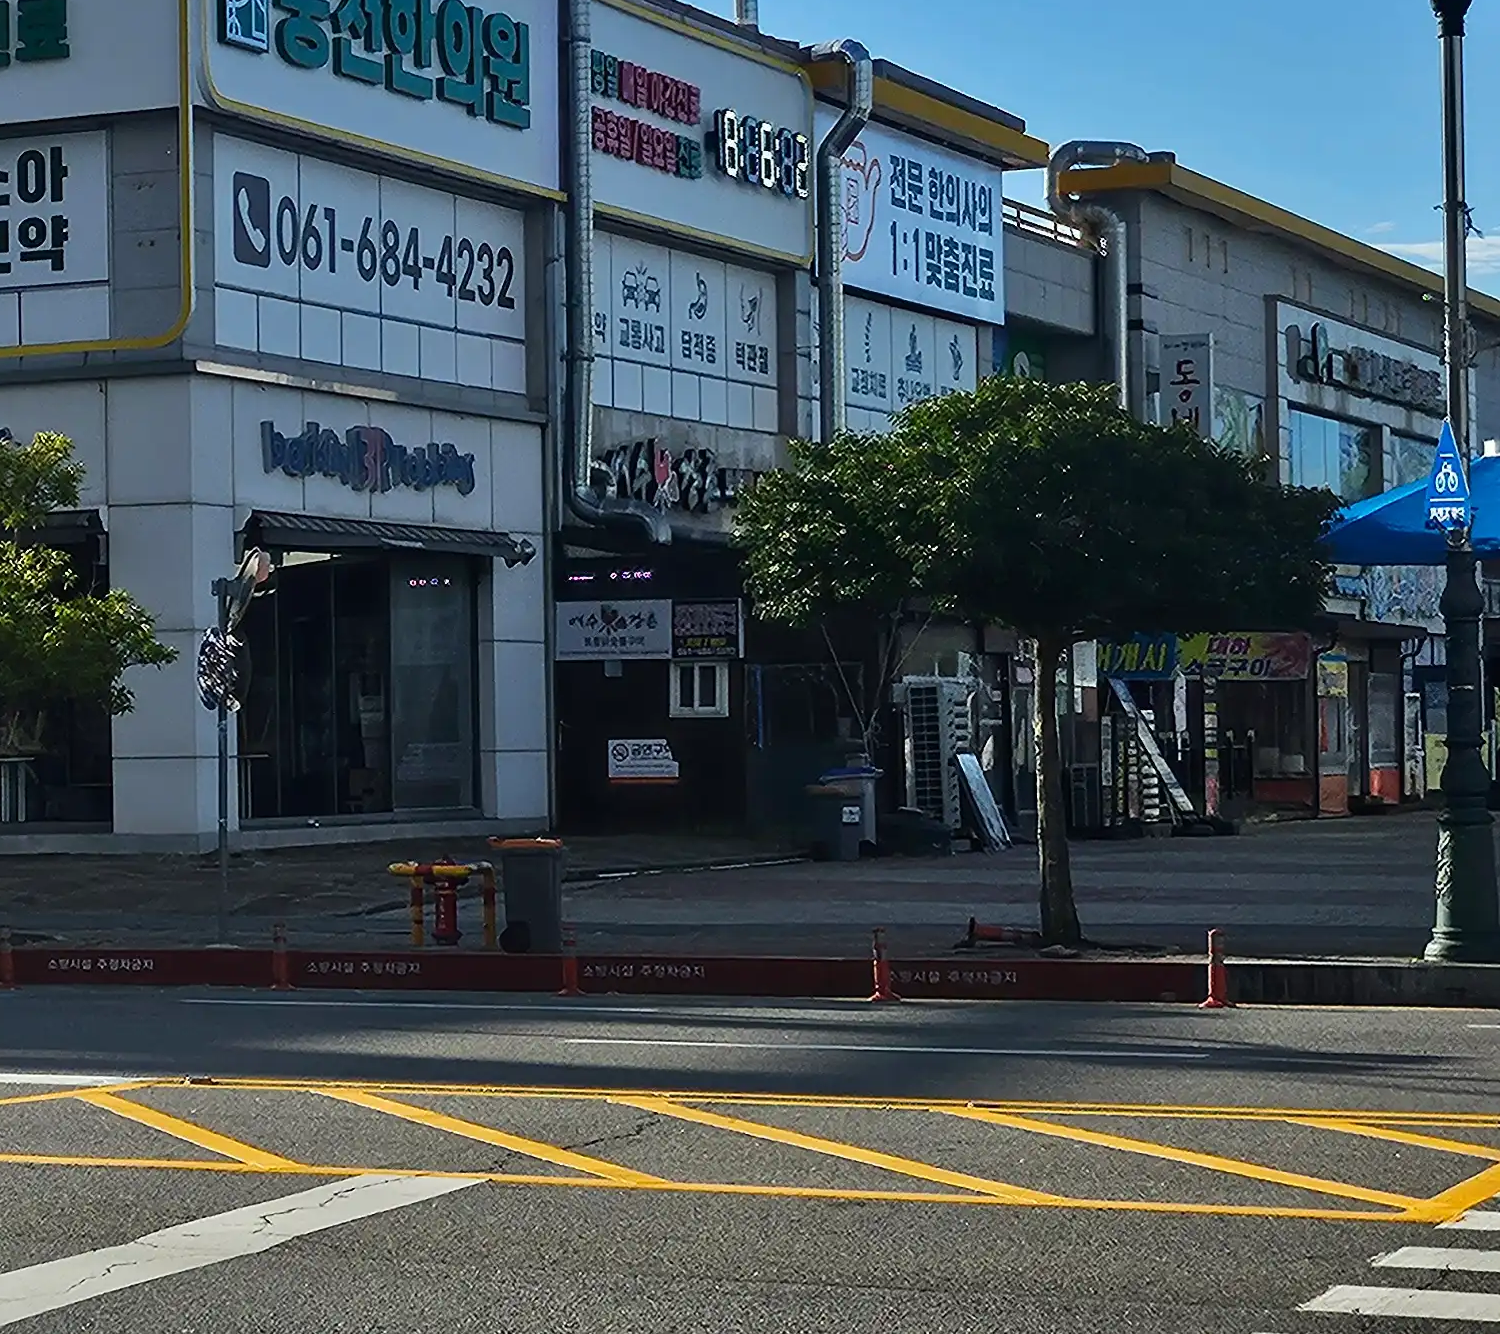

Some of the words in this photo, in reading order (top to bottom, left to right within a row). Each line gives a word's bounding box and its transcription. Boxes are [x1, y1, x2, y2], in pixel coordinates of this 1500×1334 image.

[889, 154, 923, 215] 전문
[928, 167, 993, 236] 한의사의
[277, 195, 515, 309] 061-684-4232
[890, 220, 920, 282] 1:1
[925, 231, 995, 302] 맞춤진료
[619, 317, 665, 354] 교통사고
